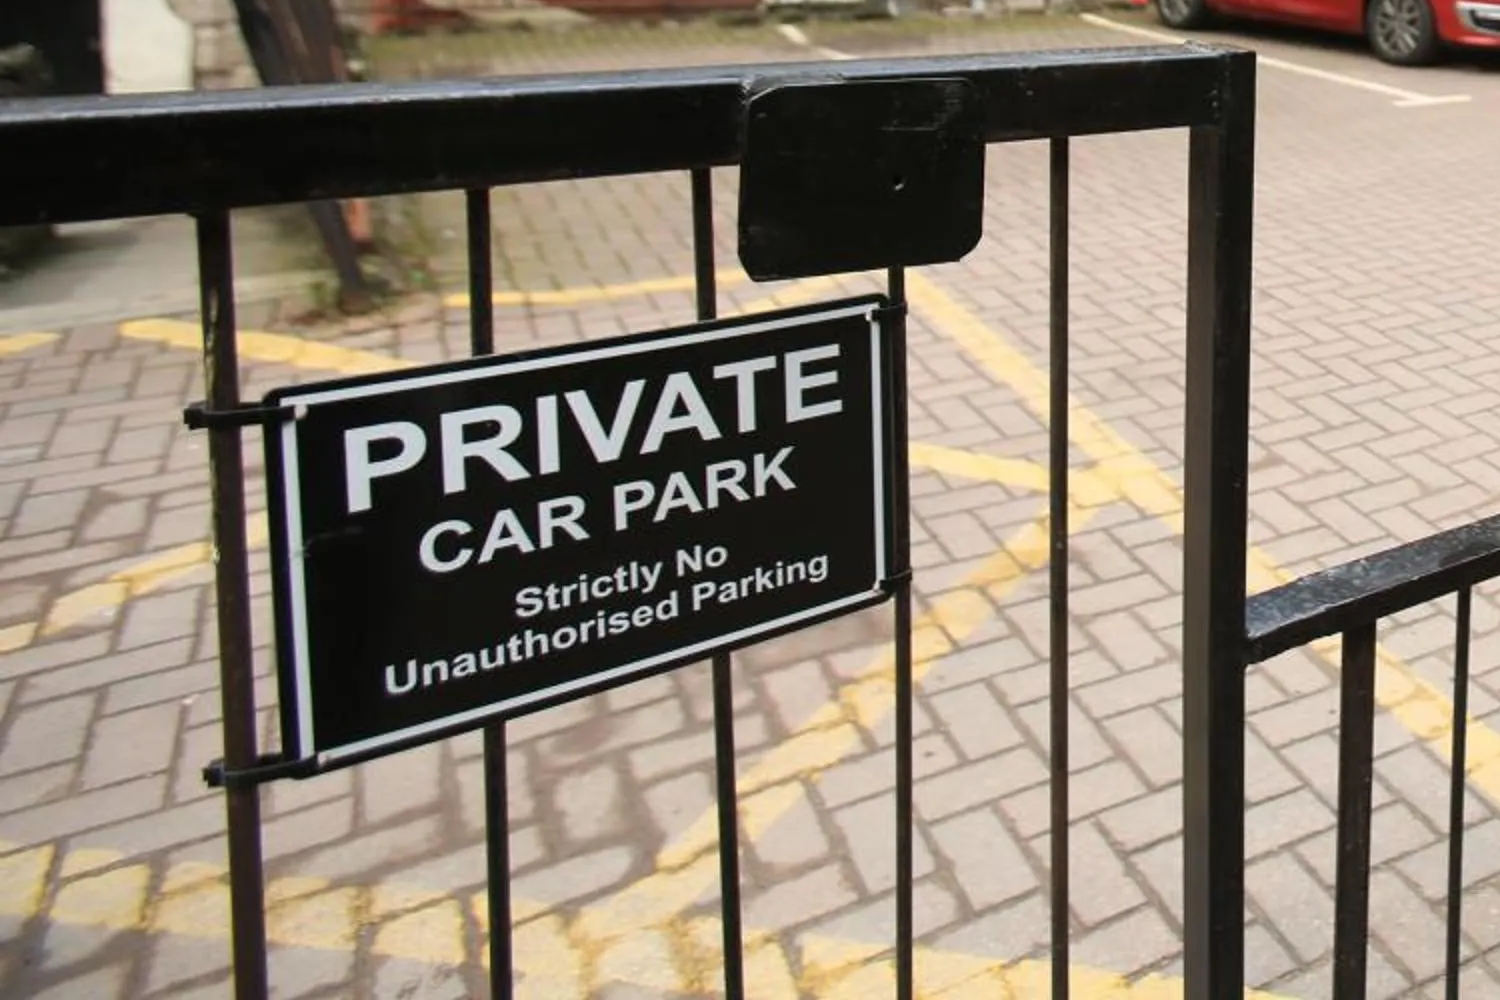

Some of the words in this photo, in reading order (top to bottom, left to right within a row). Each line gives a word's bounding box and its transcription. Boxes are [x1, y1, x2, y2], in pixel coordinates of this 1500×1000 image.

[344, 343, 843, 513] PRIVATE
[418, 495, 590, 574] CAR
[613, 446, 797, 532] PARK
[384, 590, 679, 695] Unauthorised
[691, 553, 829, 612] Parking
[514, 560, 663, 618] Strictly
[676, 544, 729, 577] No
